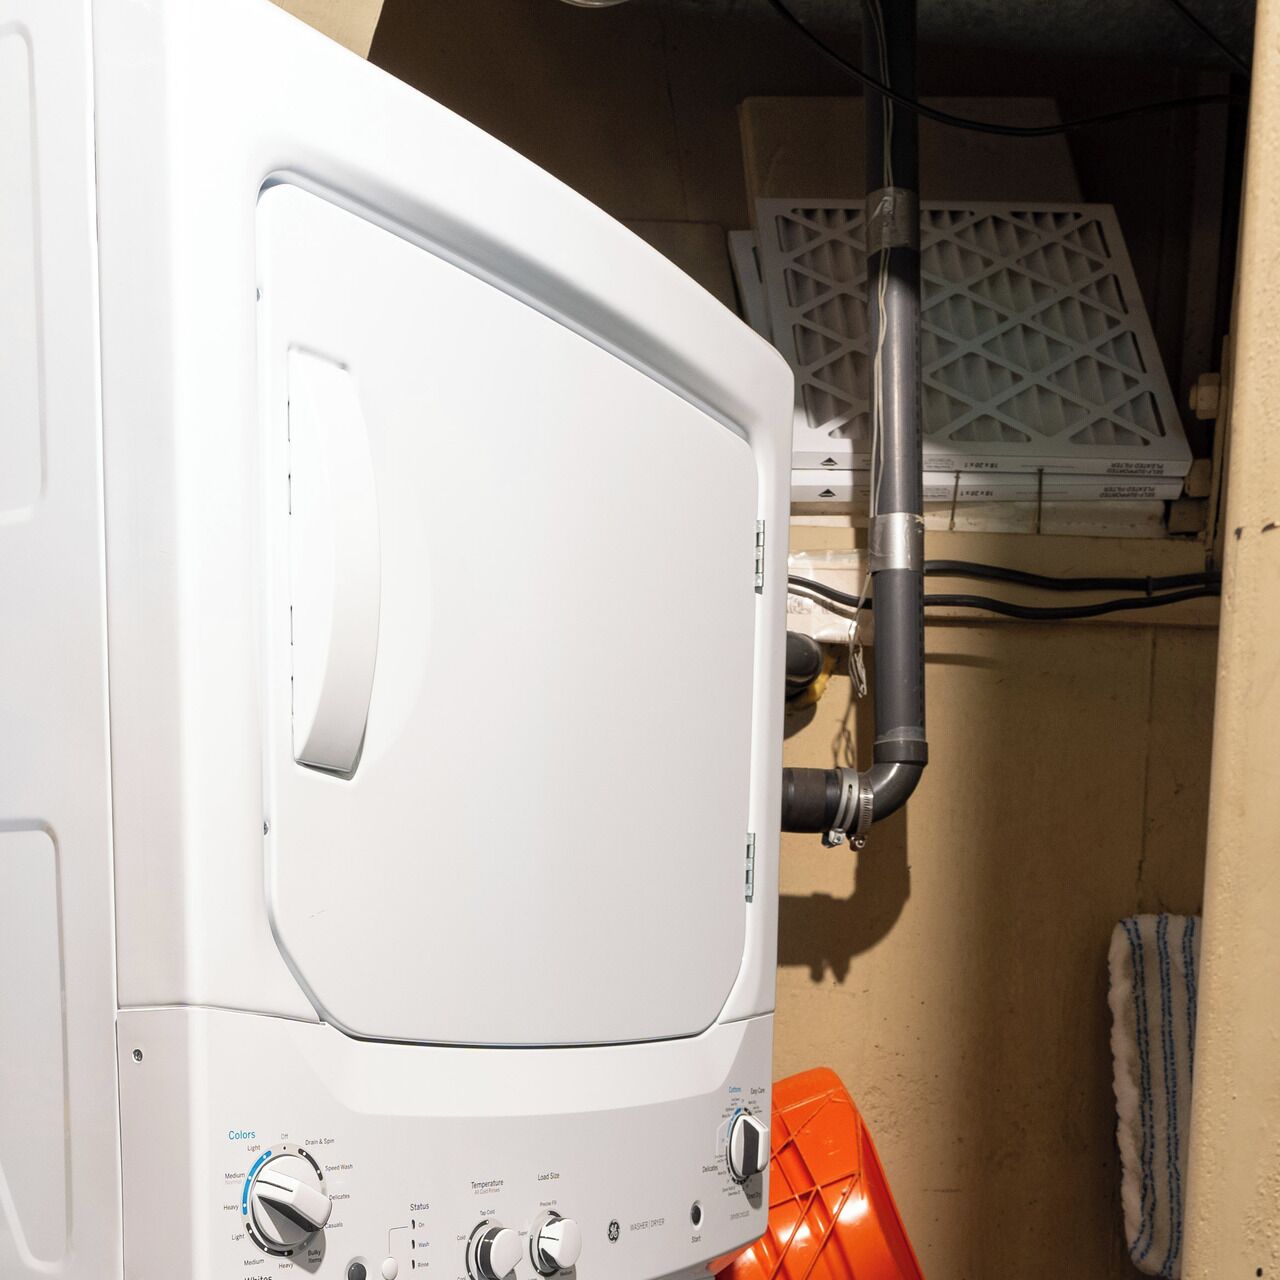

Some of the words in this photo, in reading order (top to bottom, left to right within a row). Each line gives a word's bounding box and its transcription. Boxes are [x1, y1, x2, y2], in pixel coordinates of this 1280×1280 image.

[228, 1130, 256, 1140] Colors
[247, 1144, 261, 1152] Light
[224, 1172, 246, 1180] Medium
[537, 1172, 550, 1181] Load
[550, 1171, 560, 1180] Size
[471, 1179, 504, 1190] Temperature
[329, 1193, 351, 1201] Delicates
[409, 1202, 430, 1212] Status
[231, 1233, 245, 1241] Light
[691, 1235, 701, 1244] Start
